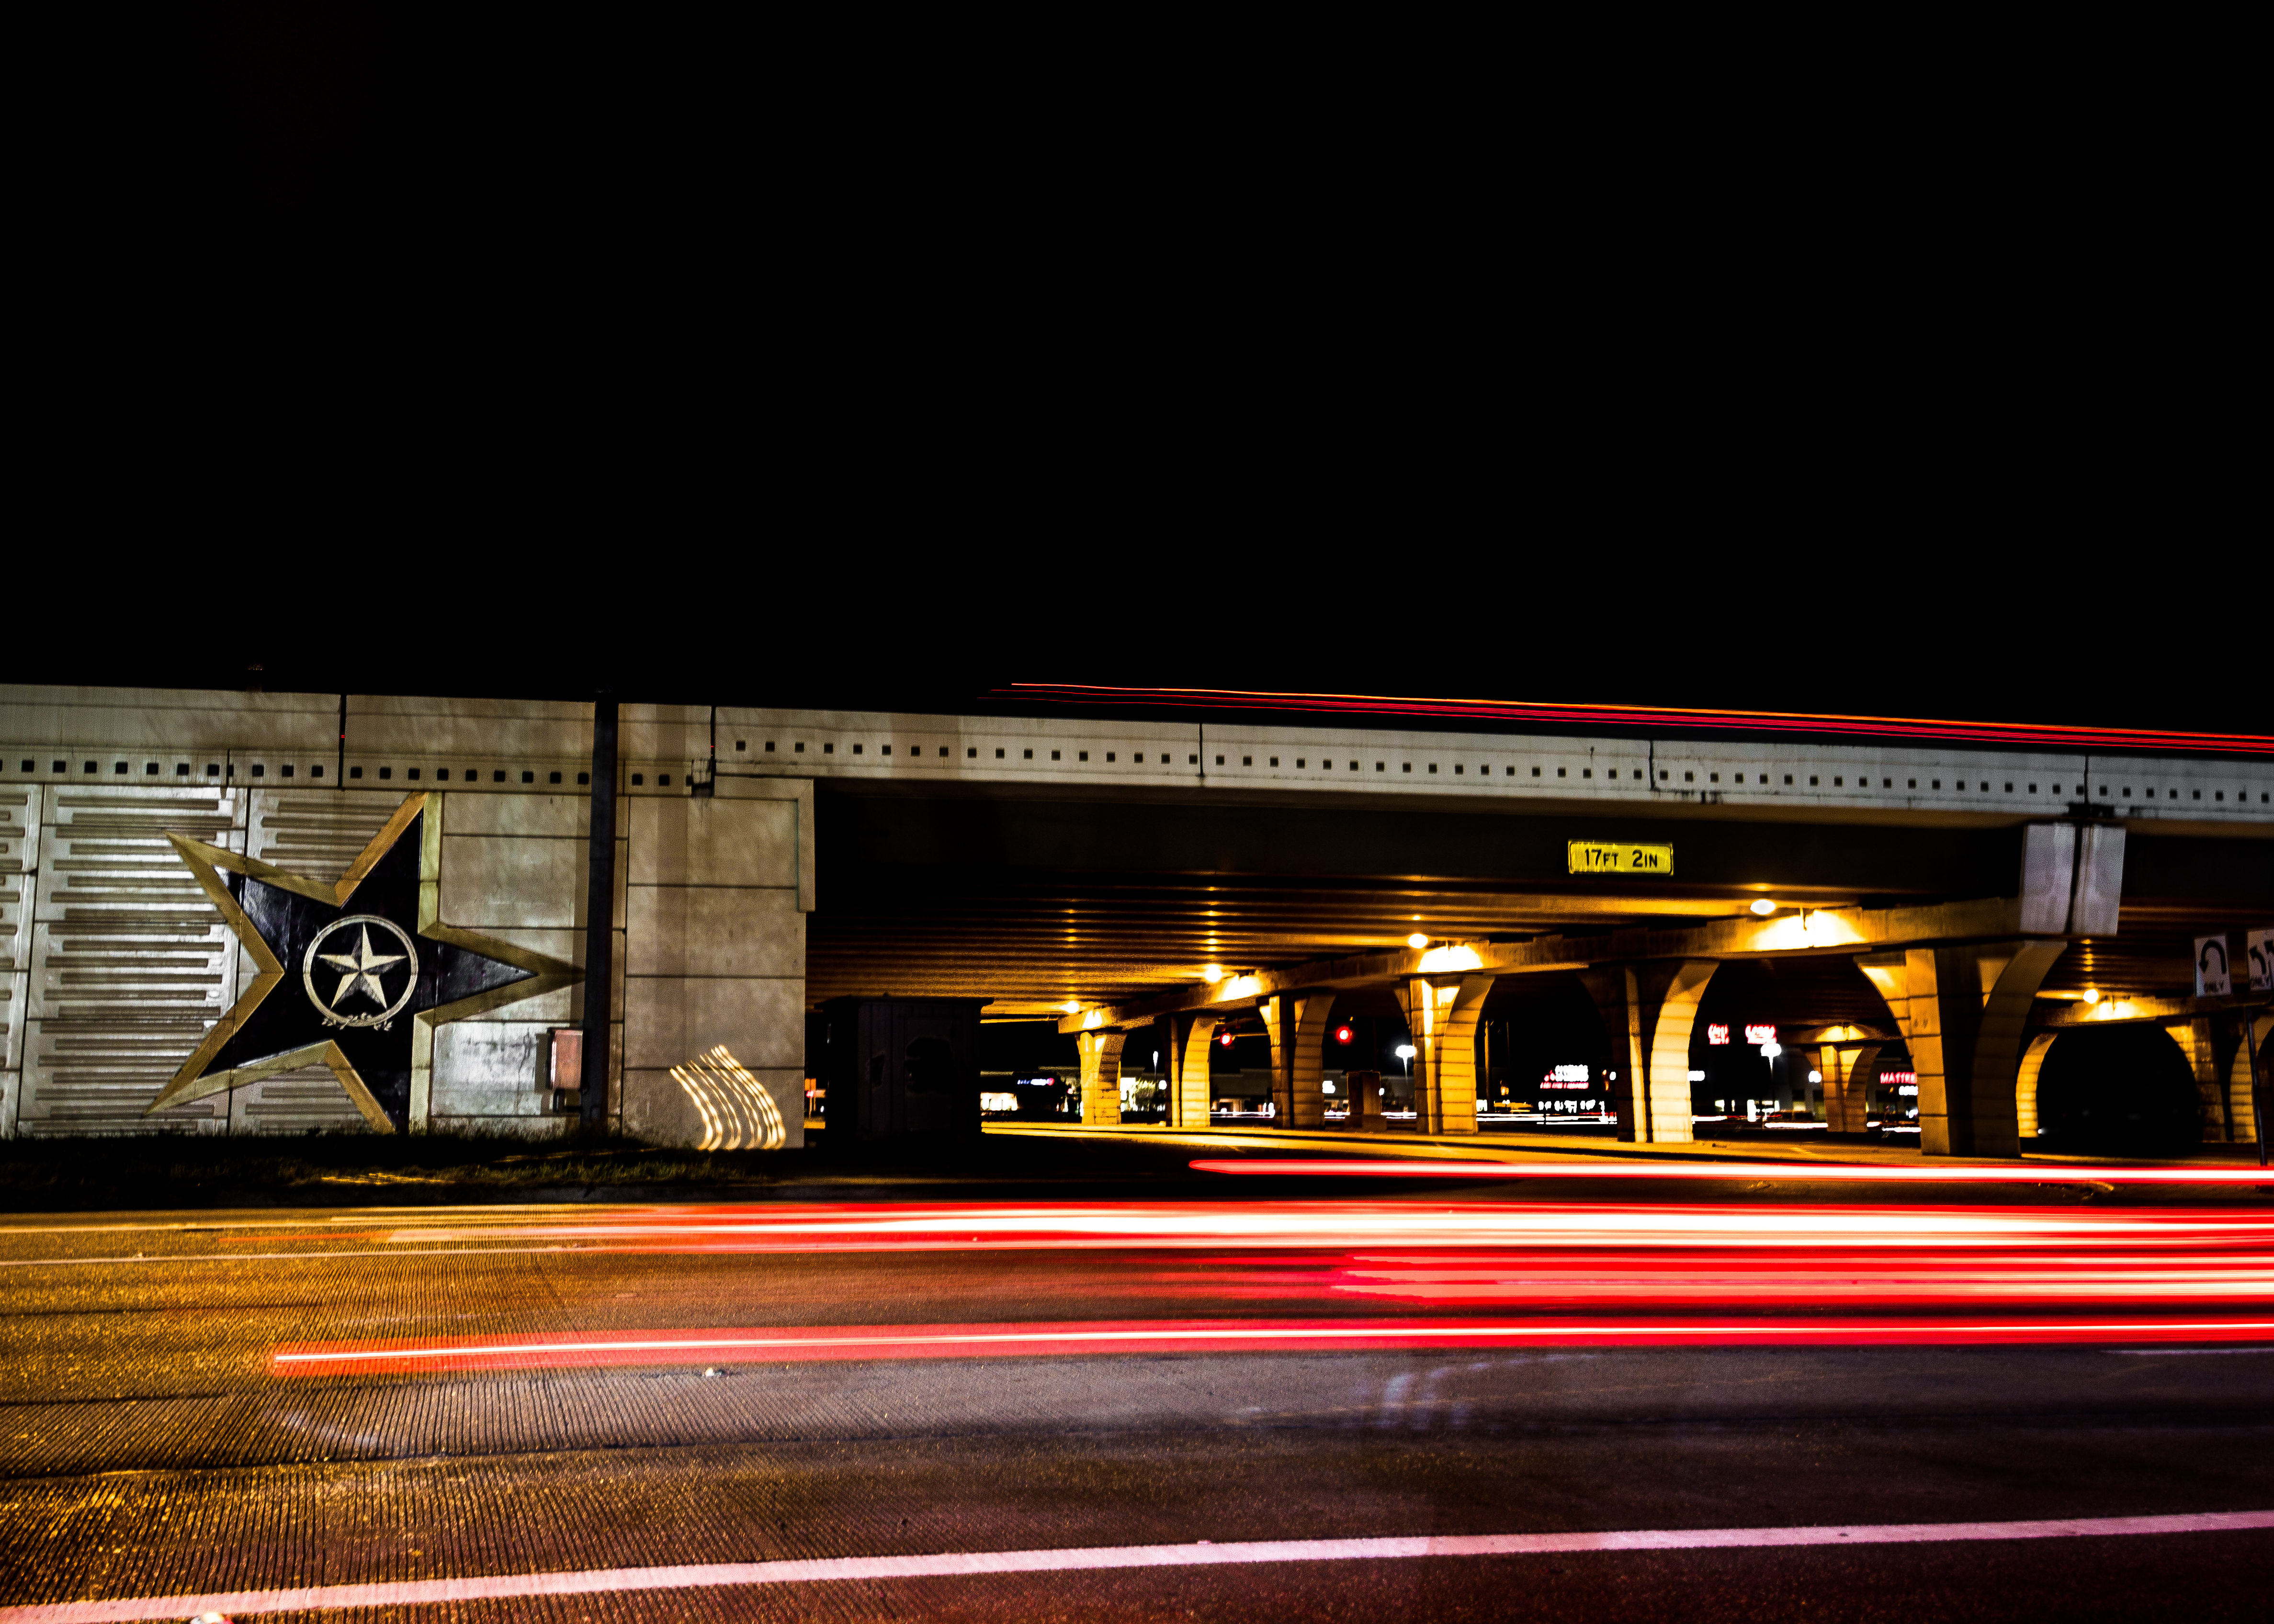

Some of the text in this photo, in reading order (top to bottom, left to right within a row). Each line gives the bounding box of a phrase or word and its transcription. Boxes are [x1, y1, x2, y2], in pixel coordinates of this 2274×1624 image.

[1584, 848, 1658, 868] 17FT 2IN
[2204, 981, 2224, 993] ONLY
[2250, 976, 2269, 988] ONLY
